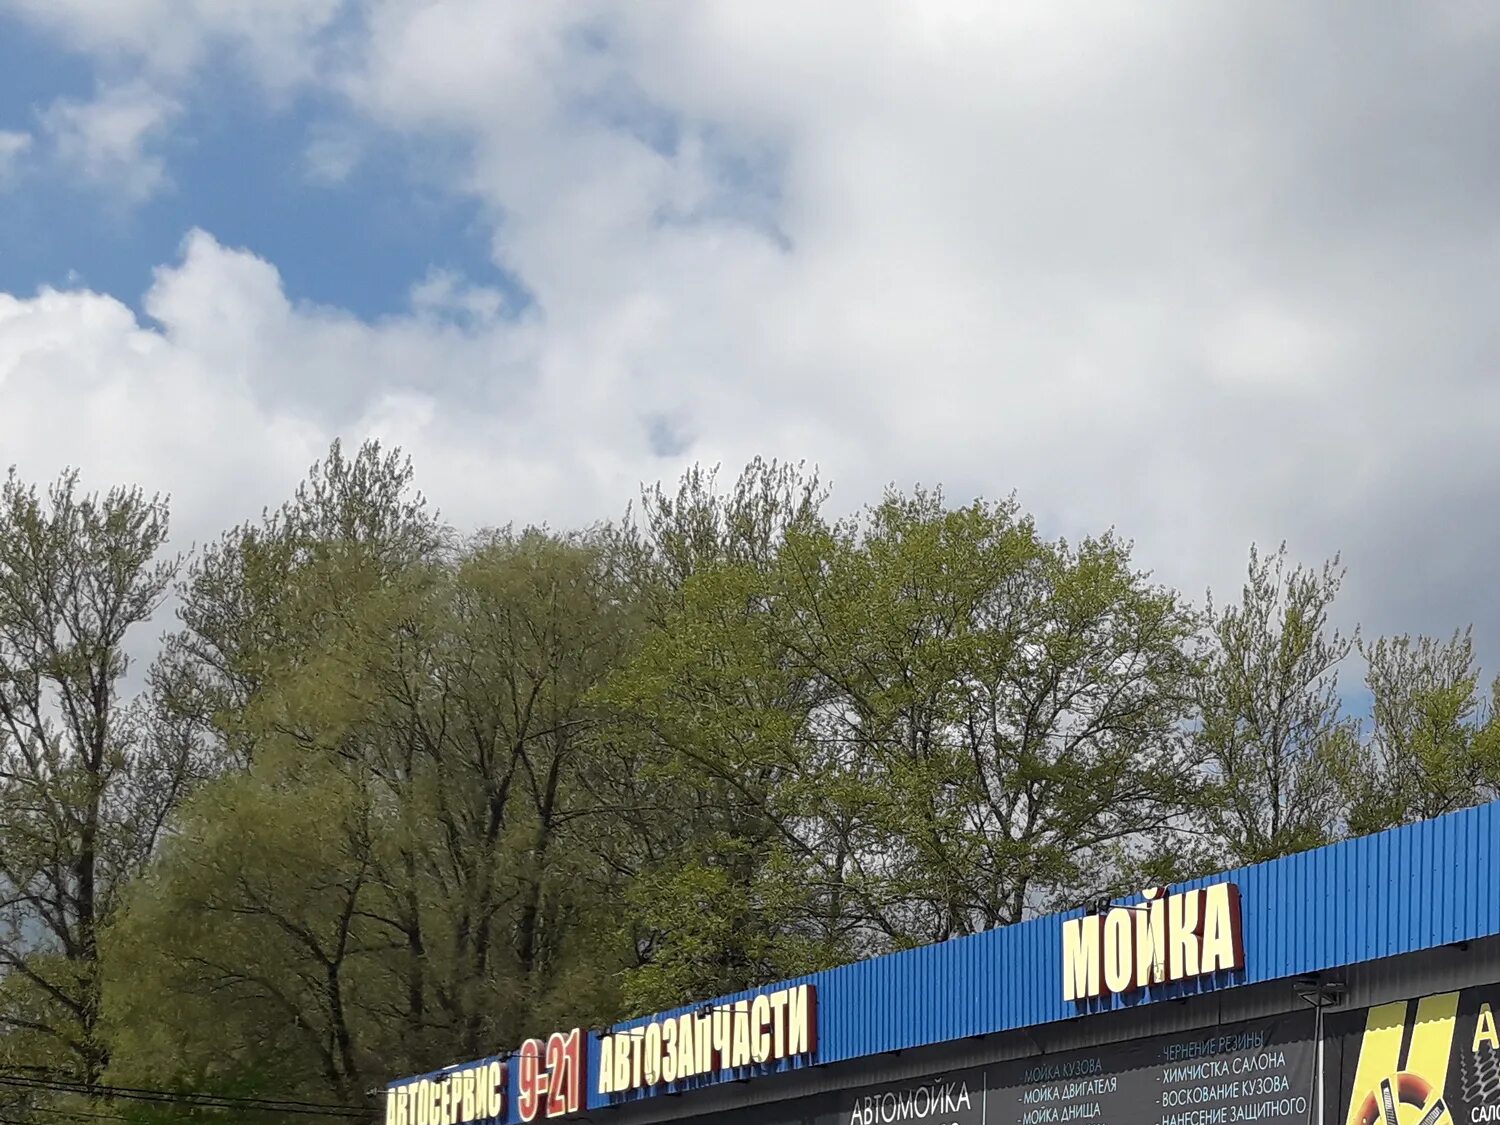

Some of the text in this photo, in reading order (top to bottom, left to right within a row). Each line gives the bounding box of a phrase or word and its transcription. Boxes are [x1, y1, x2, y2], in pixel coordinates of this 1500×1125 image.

[1063, 882, 1235, 1001] МОЙКА
[518, 1027, 584, 1122] 9-21
[598, 984, 809, 1094] АВТОЗАПЧАСТИ
[1163, 1030, 1264, 1060] ЧЕРНЕНИЕ РЕЗИНЫ
[1024, 1058, 1102, 1082] МОЙКА КУЗОВА
[1163, 1052, 1286, 1084] ХИМЧИСТКА САЛОНА
[1023, 1077, 1117, 1104] МОЙКА ДВИГАТЕЛЯ
[1162, 1075, 1289, 1107] ВОСКОВАНИЕ КУЗОВА
[1022, 1102, 1101, 1125] МОЙКА ДНИЩА
[1230, 1096, 1307, 1122] ЗАЩИТНОГО
